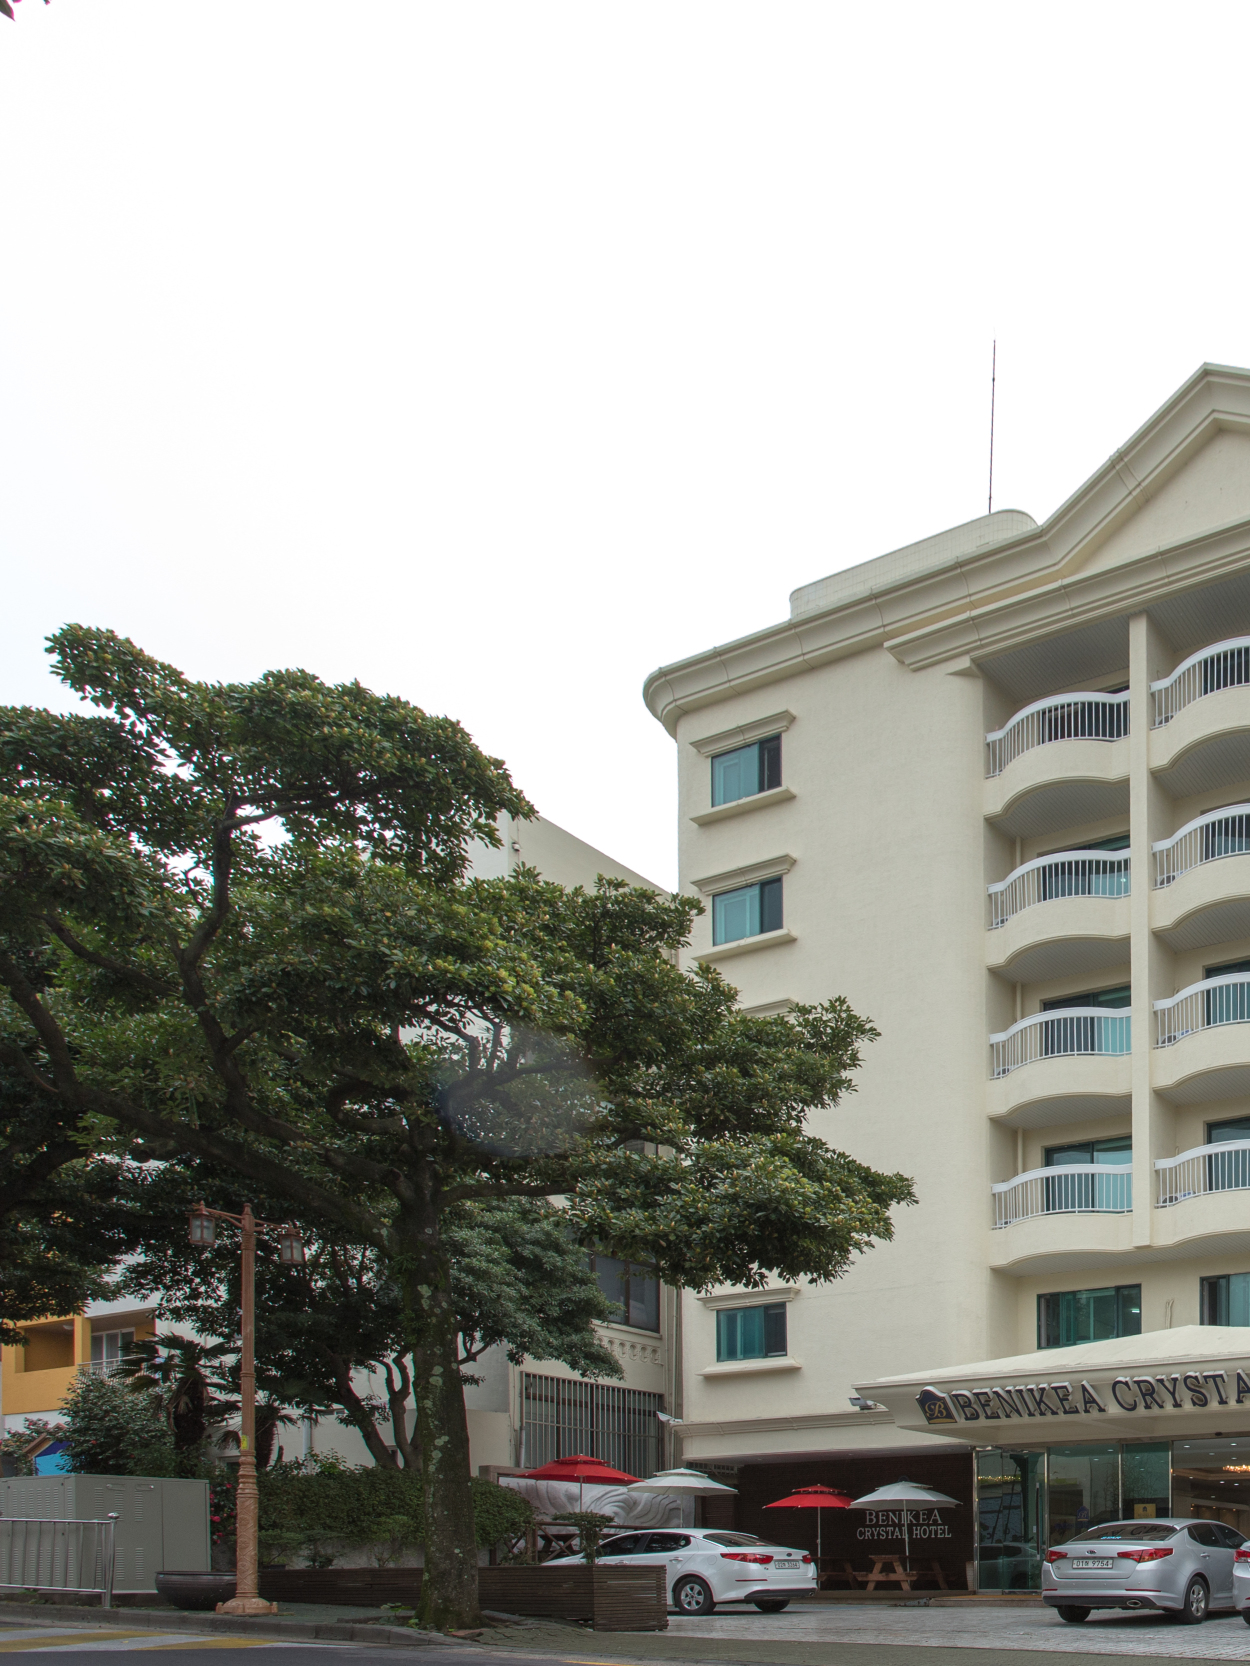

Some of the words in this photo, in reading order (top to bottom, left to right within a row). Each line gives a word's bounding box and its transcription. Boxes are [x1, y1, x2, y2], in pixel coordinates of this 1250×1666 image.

[951, 1380, 1107, 1421] BENIKEA
[865, 1509, 943, 1525] BENIKEA
[857, 1527, 908, 1540] CRYSTAL
[913, 1525, 952, 1538] HOTEL
[1091, 1558, 1110, 1567] 9754
